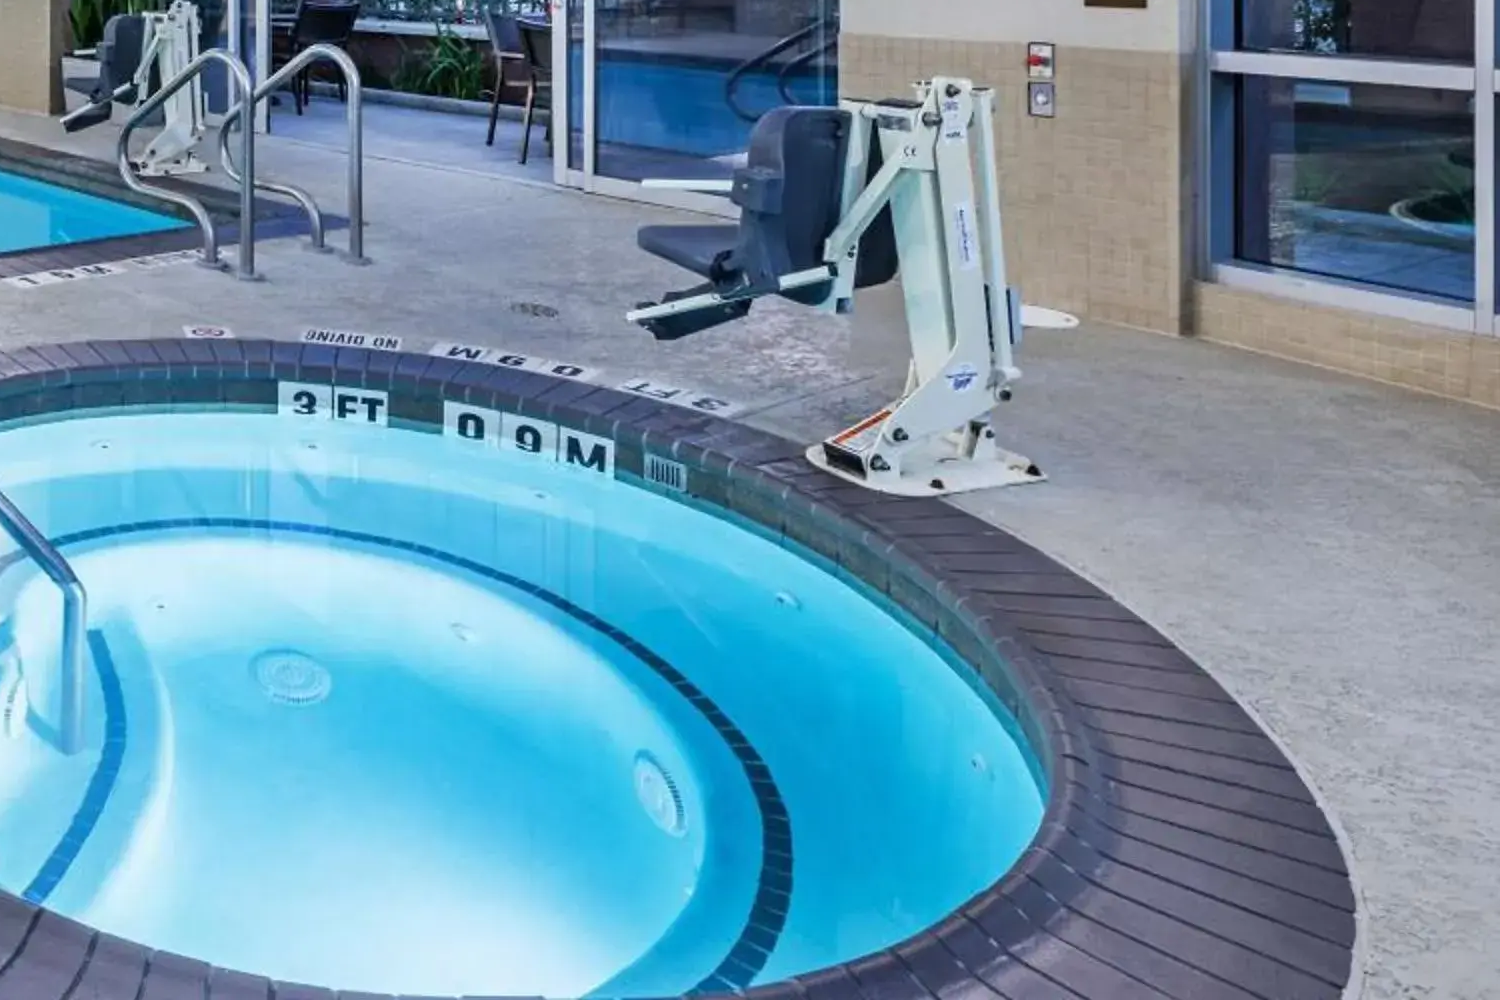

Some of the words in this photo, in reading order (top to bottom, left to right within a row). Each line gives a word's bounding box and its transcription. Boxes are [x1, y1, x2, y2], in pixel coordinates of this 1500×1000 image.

[304, 329, 365, 346] DIVING
[372, 336, 398, 349] NO
[293, 391, 317, 415] 3
[337, 393, 385, 423] FT
[566, 435, 607, 473] M
